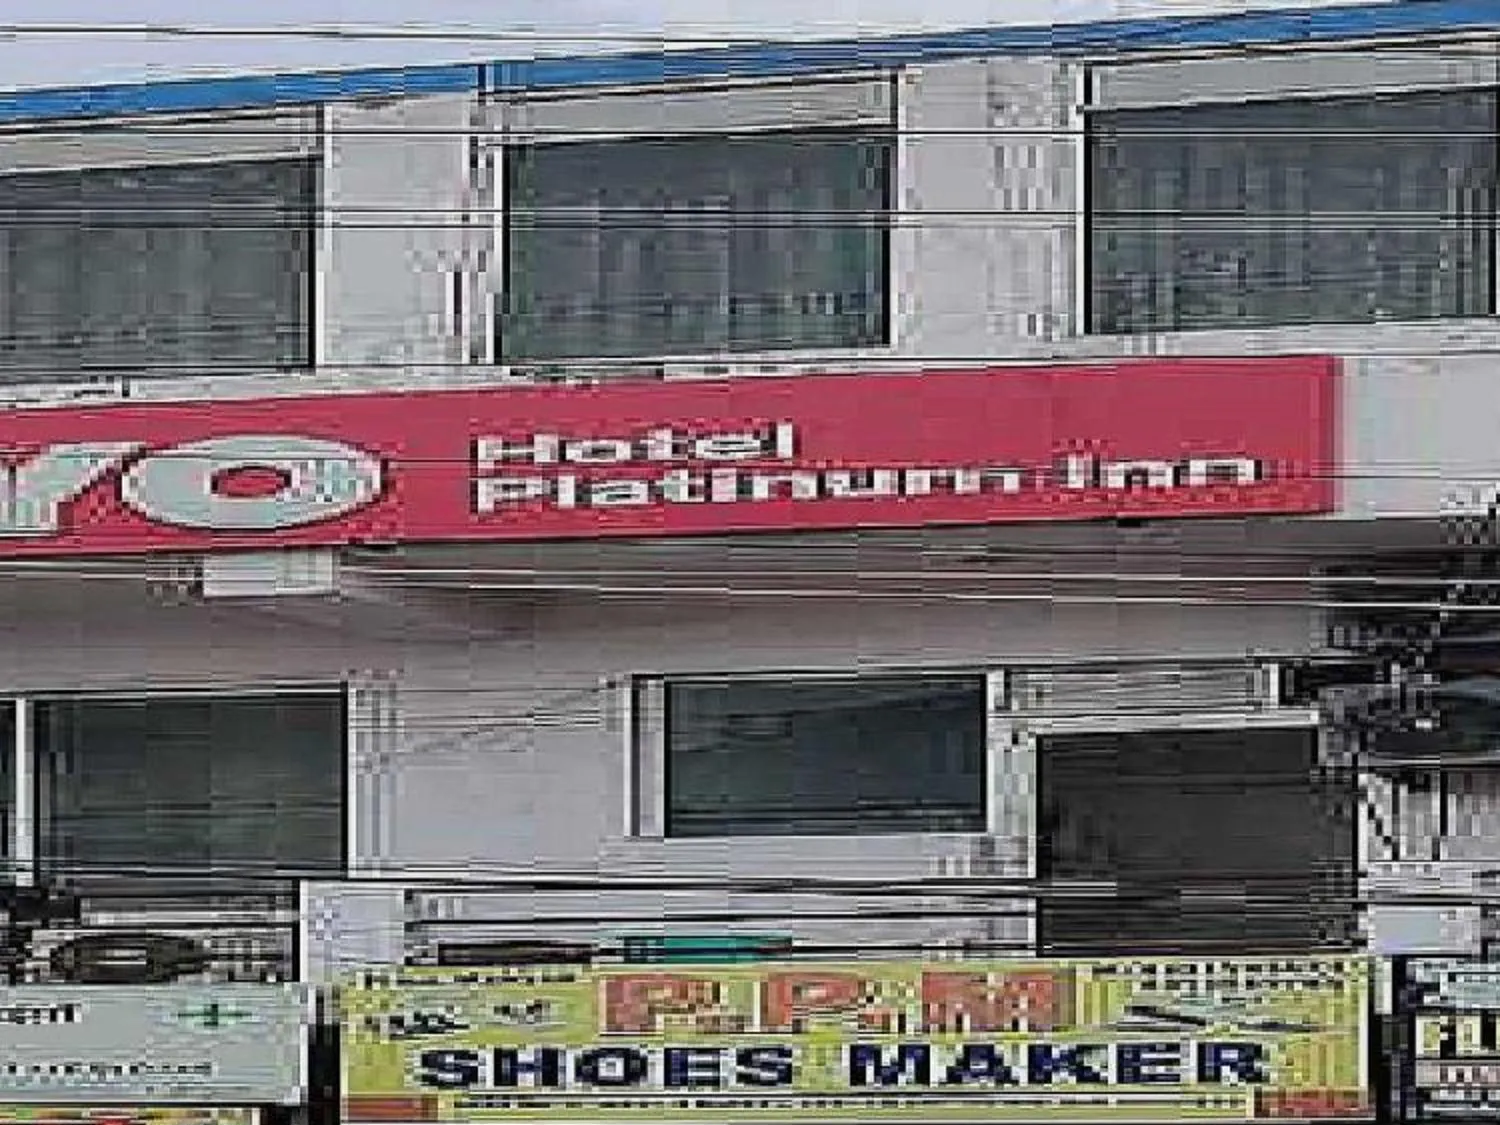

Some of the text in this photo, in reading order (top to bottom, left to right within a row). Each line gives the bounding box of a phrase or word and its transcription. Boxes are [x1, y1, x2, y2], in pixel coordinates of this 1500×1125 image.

[476, 423, 794, 468] Hotel
[476, 463, 1022, 513] Platinum
[414, 1041, 1273, 1090] SHOES MAKER
